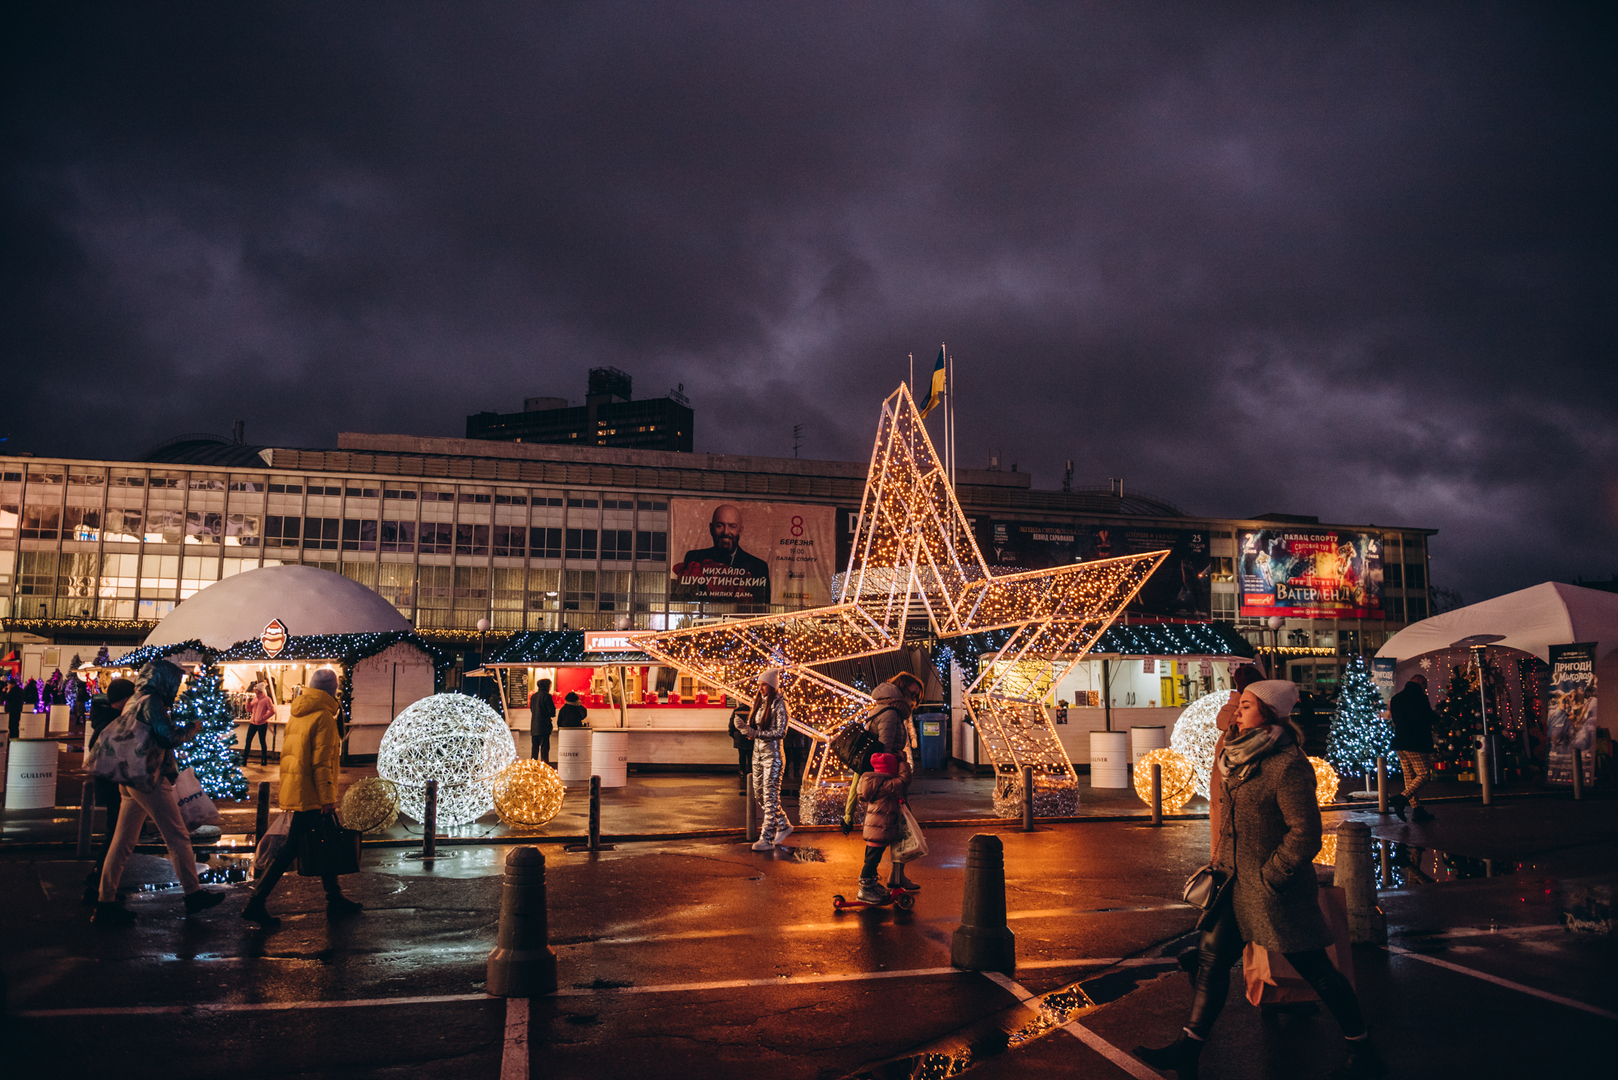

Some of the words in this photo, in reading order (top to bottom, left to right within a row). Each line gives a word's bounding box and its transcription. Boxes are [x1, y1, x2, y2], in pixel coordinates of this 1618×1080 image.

[790, 515, 804, 537] 8
[780, 538, 814, 546] БЕРЕЗНЯ
[1192, 534, 1202, 543] 25
[1245, 533, 1254, 548] 2
[1284, 533, 1309, 541] ПАЛАЦ
[1310, 534, 1338, 542] СПОРТУ
[1368, 539, 1378, 553] 4
[702, 567, 746, 576] МИХАЙЛО
[680, 575, 767, 587] ШУФУТИНСЬКИЙ
[1554, 660, 1592, 673] ПРИГОДИ
